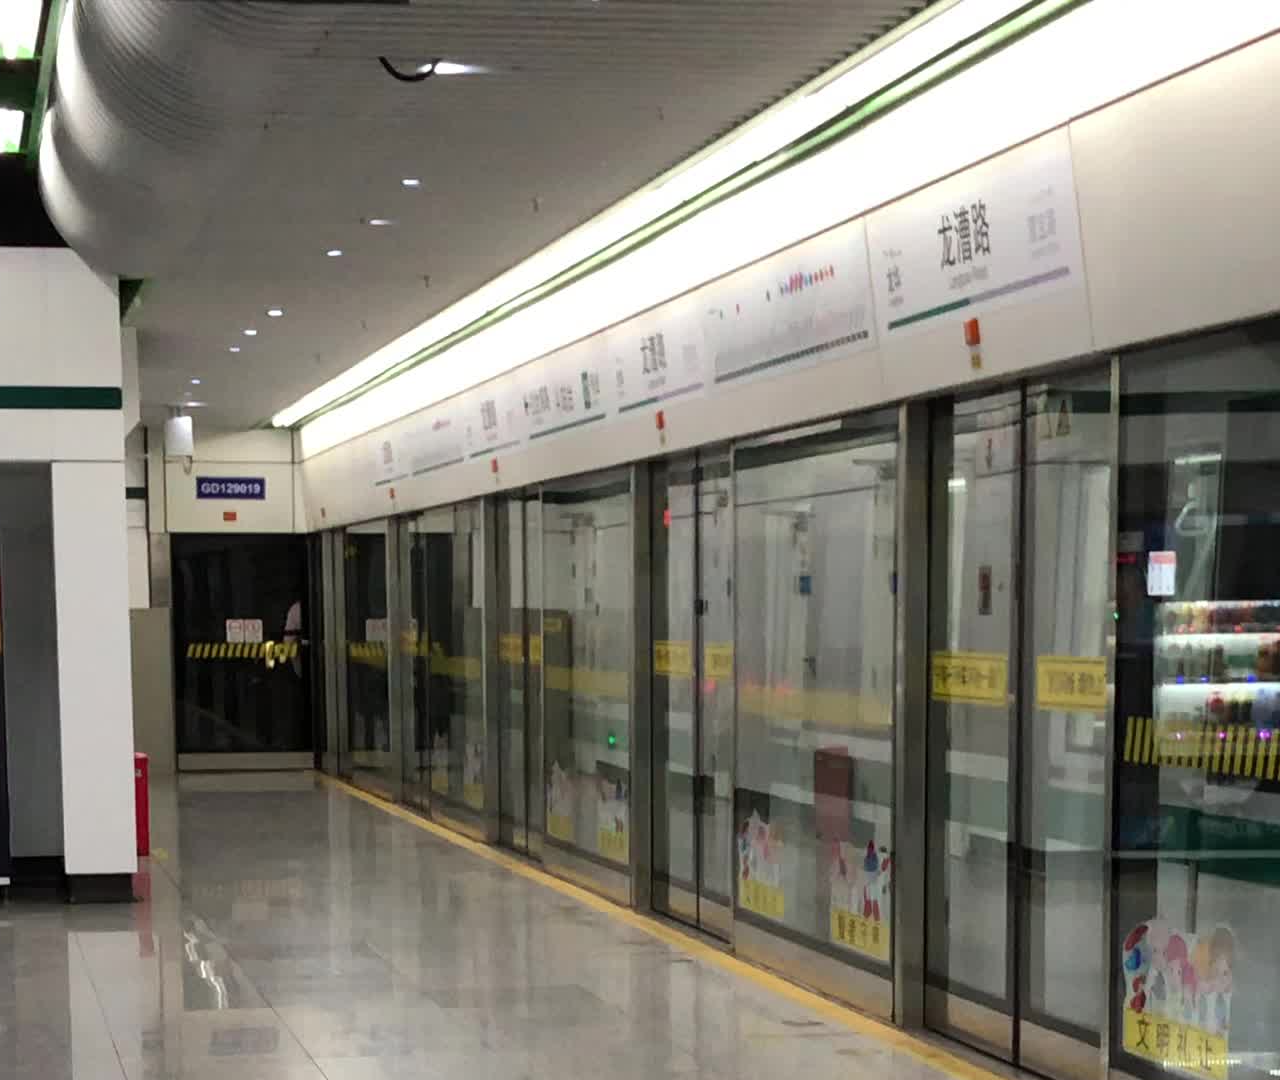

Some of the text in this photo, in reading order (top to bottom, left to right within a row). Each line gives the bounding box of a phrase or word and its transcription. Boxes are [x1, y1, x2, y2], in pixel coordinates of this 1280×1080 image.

[937, 199, 991, 272] 龙漕路
[1135, 1017, 1214, 1073] 文明礼让
